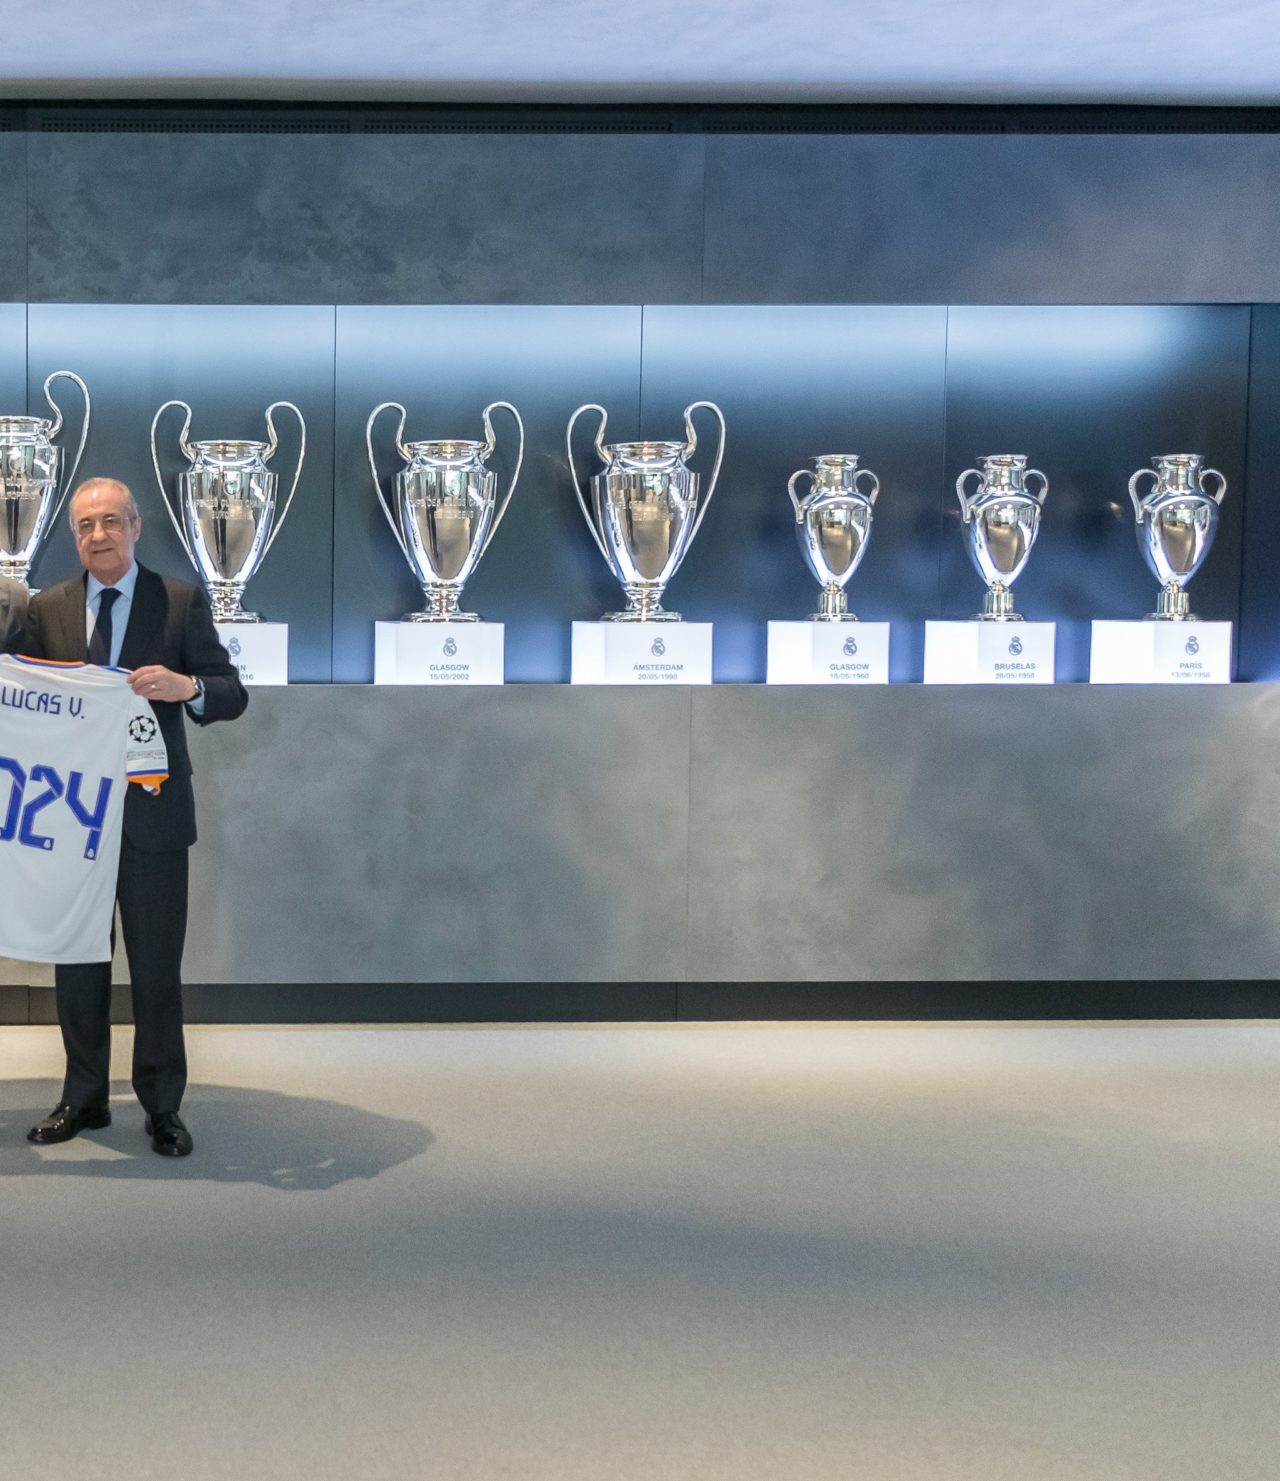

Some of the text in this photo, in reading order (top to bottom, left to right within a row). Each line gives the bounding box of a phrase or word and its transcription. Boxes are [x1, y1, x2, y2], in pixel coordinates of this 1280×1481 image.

[829, 663, 870, 671] GLASGOW
[994, 662, 1036, 670] BRUSELAS
[430, 673, 470, 681] 15/05/2002
[1, 686, 86, 719] LUCAS V.
